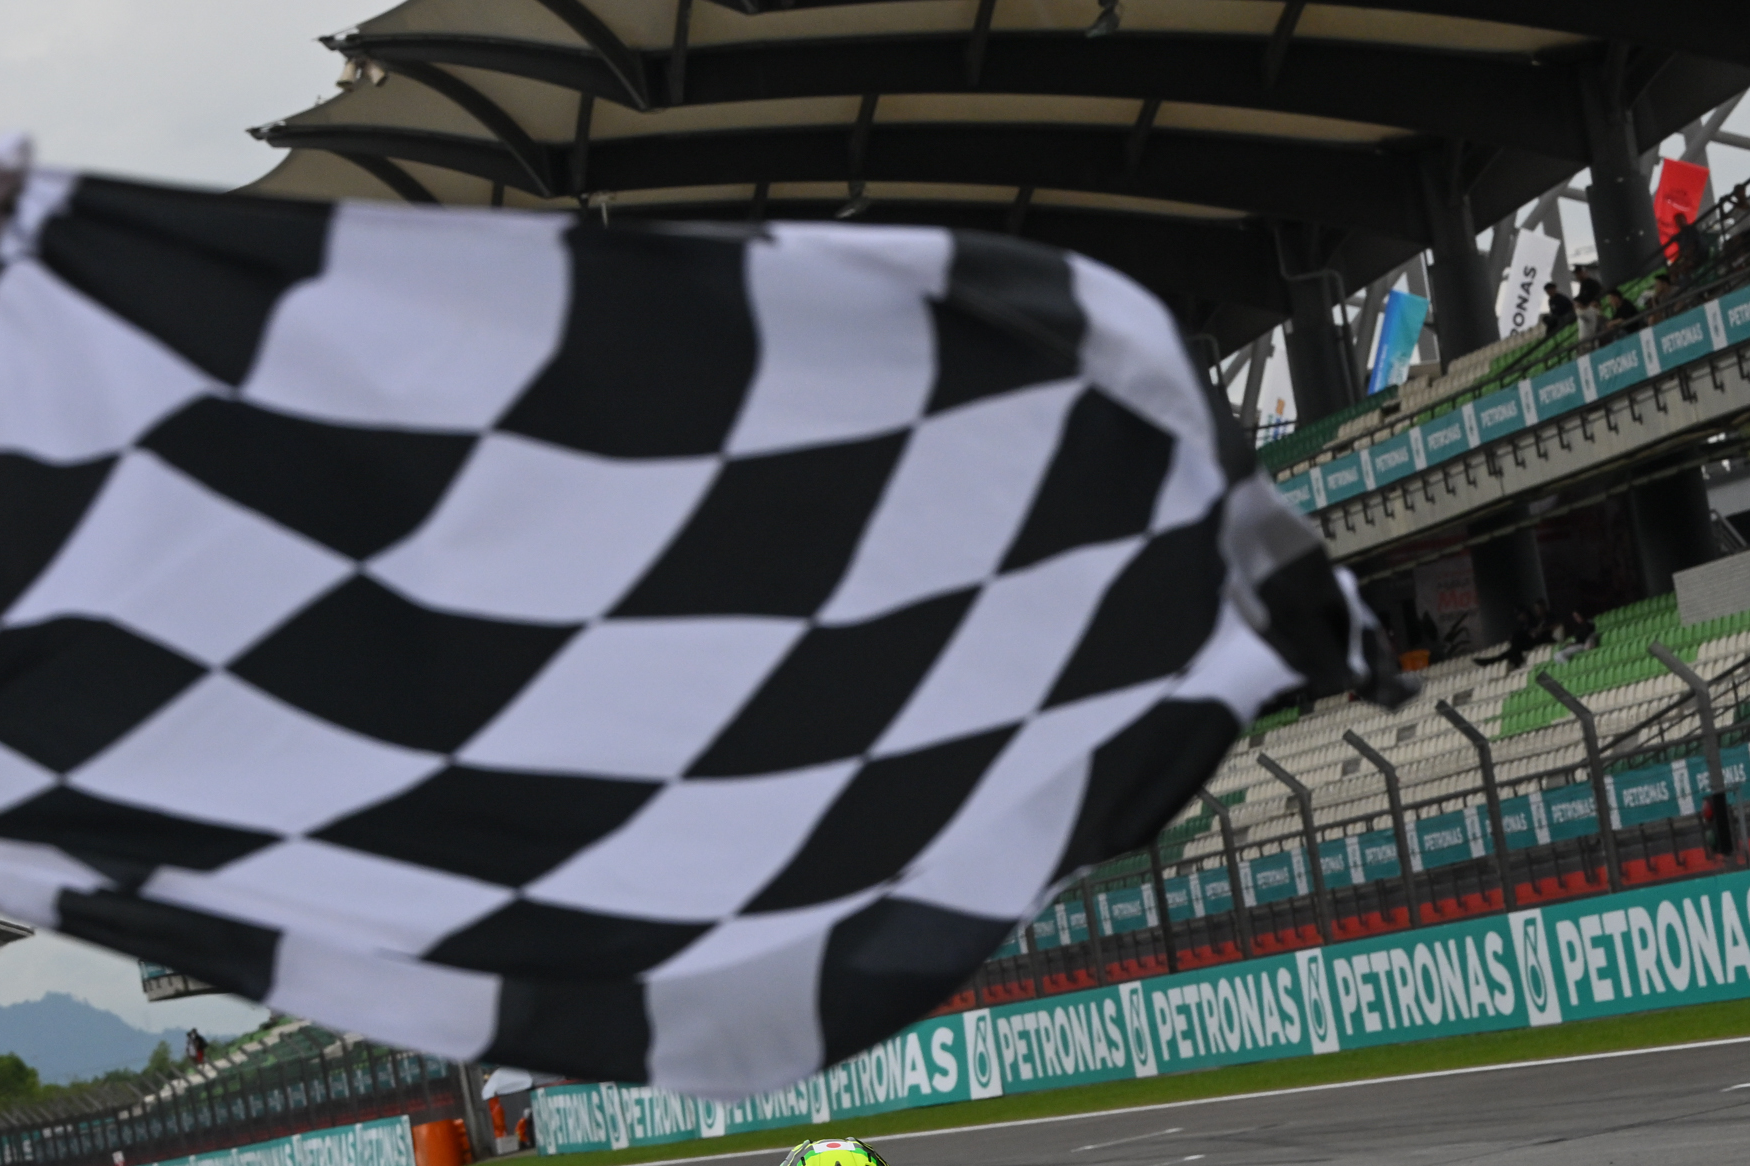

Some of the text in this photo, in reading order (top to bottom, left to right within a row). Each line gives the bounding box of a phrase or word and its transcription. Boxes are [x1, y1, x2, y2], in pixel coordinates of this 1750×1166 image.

[1597, 350, 1639, 380] PETRONAS
[1661, 322, 1704, 355] PETRONAS
[1622, 780, 1670, 809] PETRONAS
[1696, 763, 1747, 796] PEONAS
[1333, 930, 1516, 1036] PETRONAS
[997, 998, 1126, 1083] PETRONAS
[1152, 967, 1302, 1062] PETRONAS
[828, 1026, 959, 1110] PETRONAS
